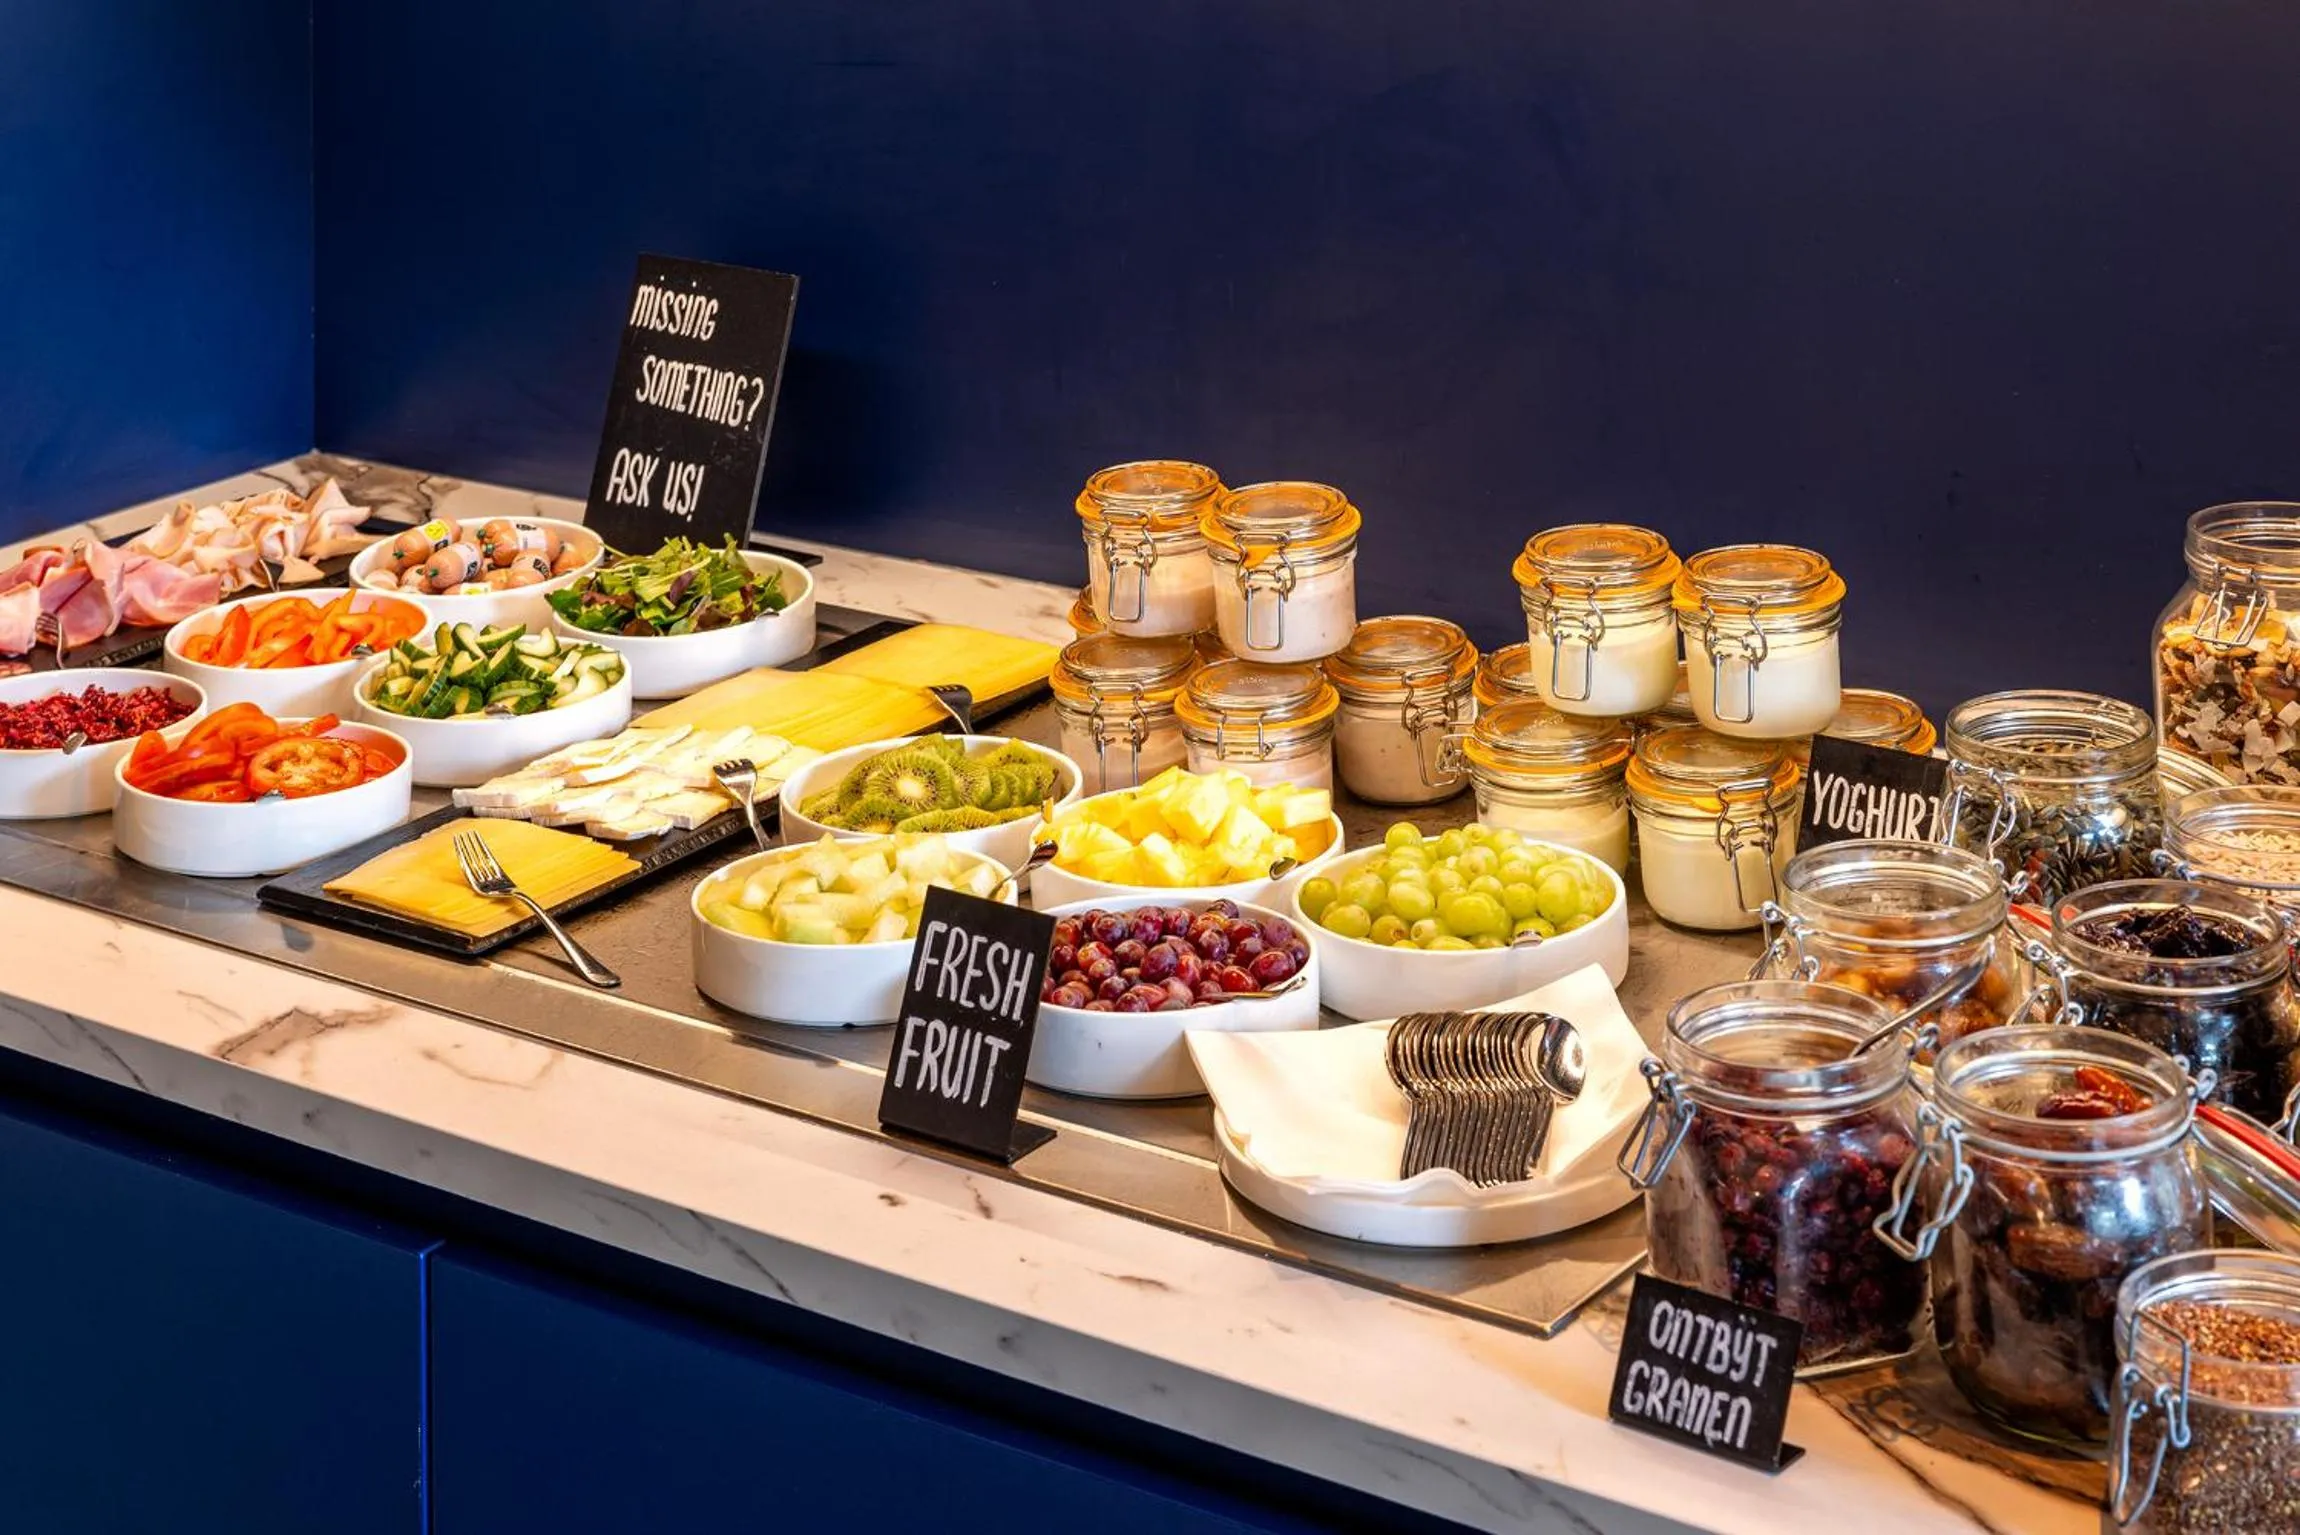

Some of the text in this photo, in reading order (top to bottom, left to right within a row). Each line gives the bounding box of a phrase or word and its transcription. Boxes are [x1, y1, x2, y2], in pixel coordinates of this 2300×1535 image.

[605, 447, 704, 522] ASK US!
[914, 919, 1035, 1021] FRESH
[893, 1016, 1012, 1108] FRUIT
